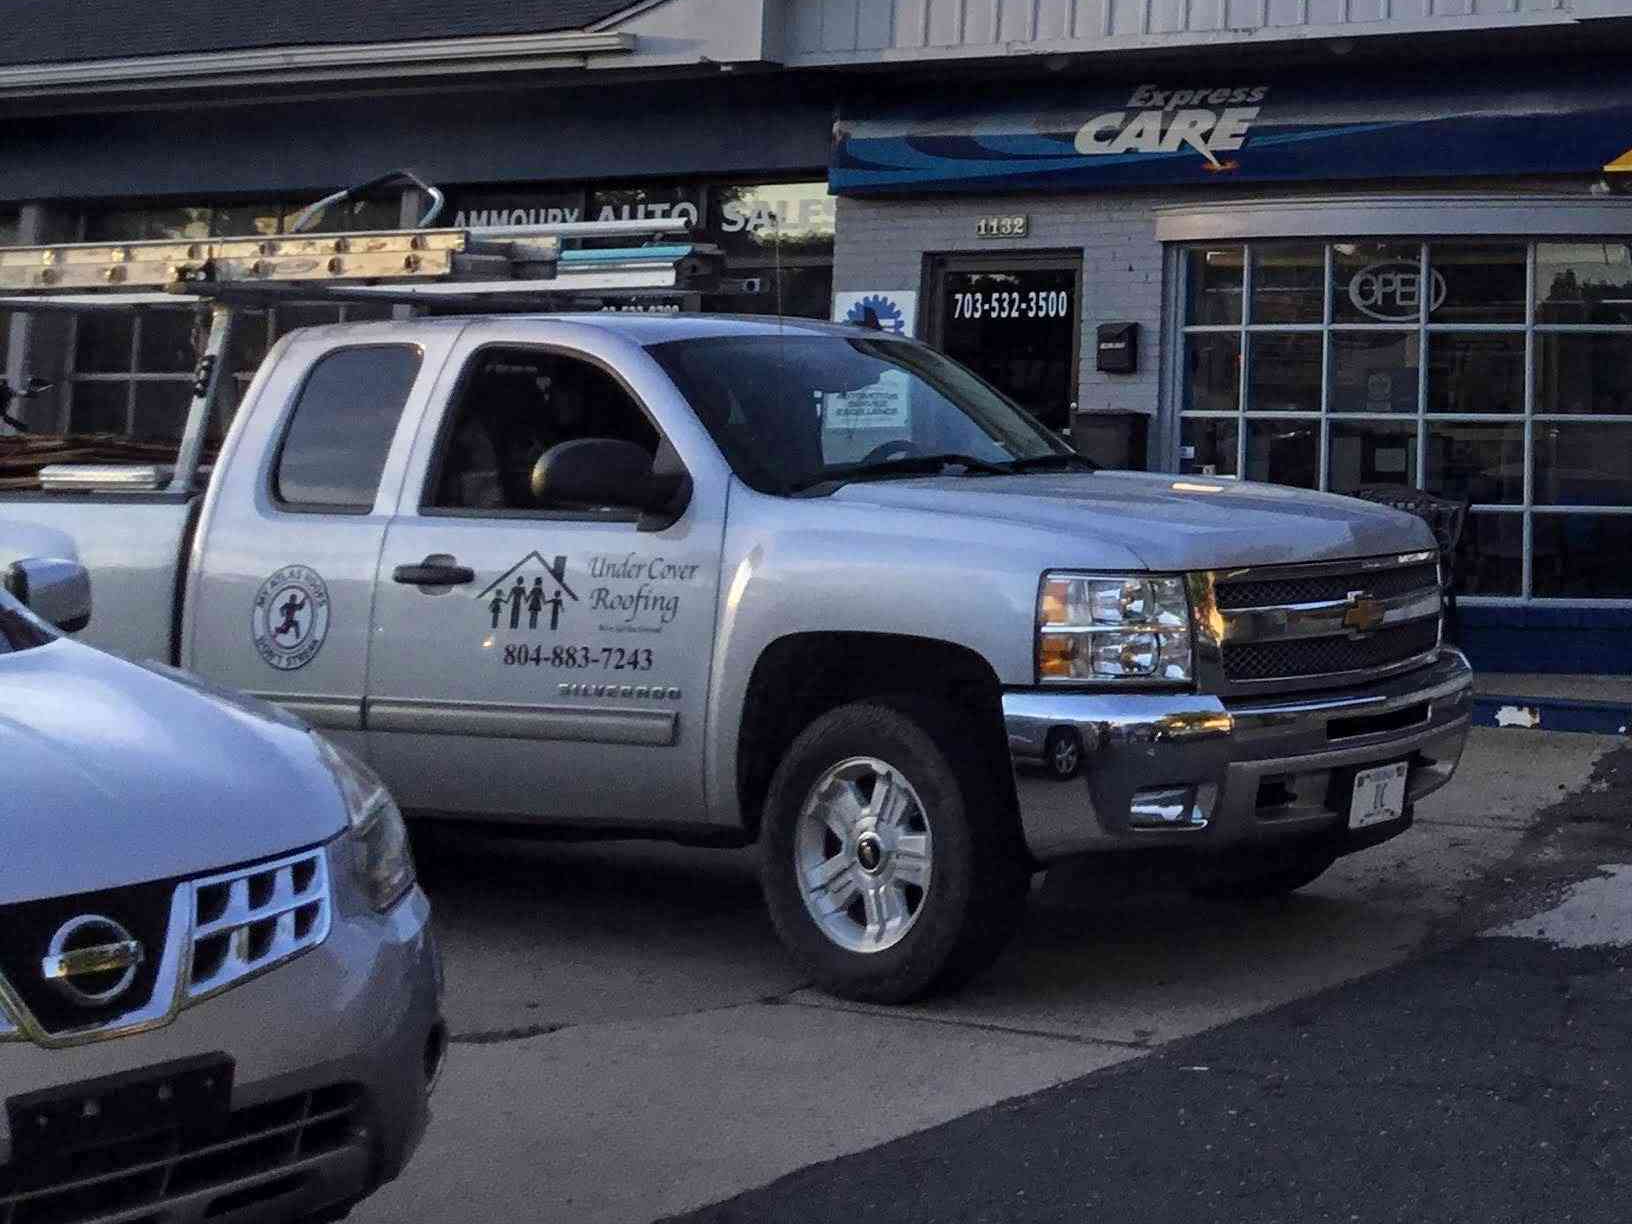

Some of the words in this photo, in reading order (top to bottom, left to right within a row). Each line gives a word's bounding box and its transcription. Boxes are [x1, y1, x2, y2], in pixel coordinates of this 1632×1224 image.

[1127, 84, 1267, 111] Express
[1074, 106, 1260, 169] CARE
[954, 291, 1068, 319] 703-532-3500
[590, 584, 681, 624] Roofing
[503, 644, 653, 671] 804-883-7243
